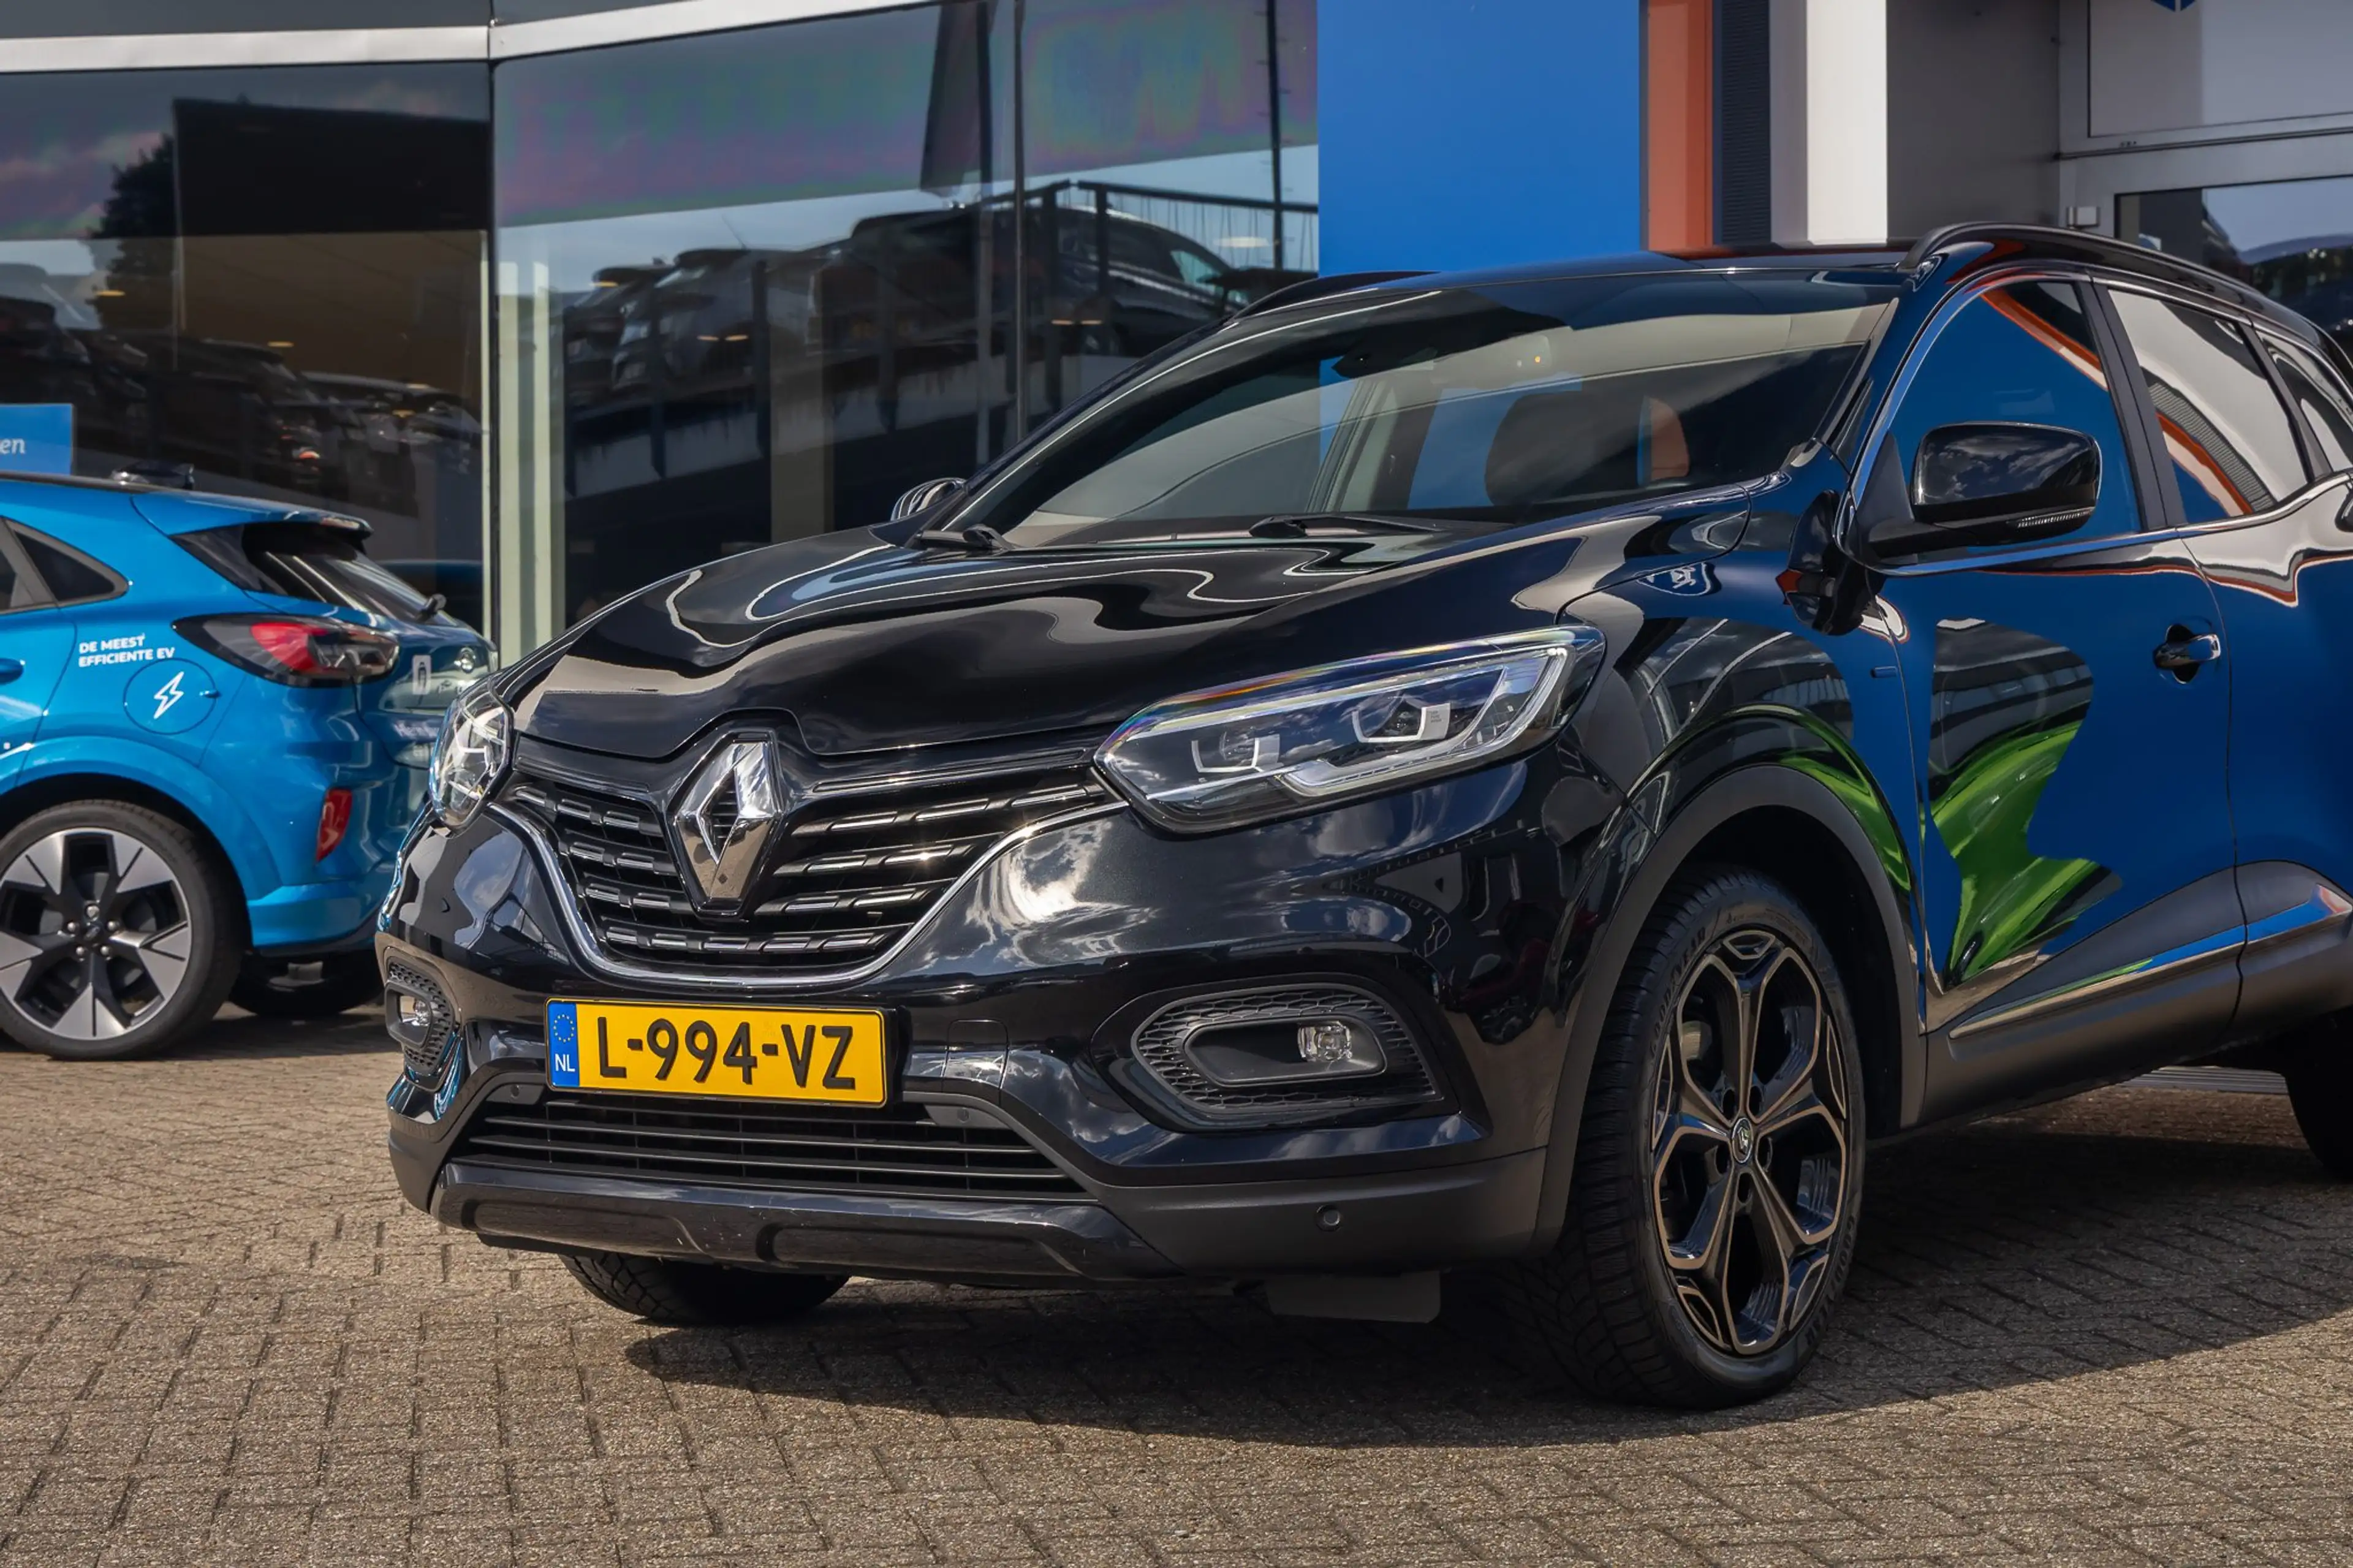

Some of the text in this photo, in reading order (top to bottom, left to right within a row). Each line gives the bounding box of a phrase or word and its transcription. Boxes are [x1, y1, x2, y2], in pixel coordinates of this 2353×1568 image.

[79, 634, 145, 654] DE MEEST
[78, 647, 175, 667] EFFICIENTE EV
[1648, 926, 1706, 1058] GOODYEAR
[555, 1053, 575, 1072] NL
[597, 1017, 855, 1090] L-994-VZ
